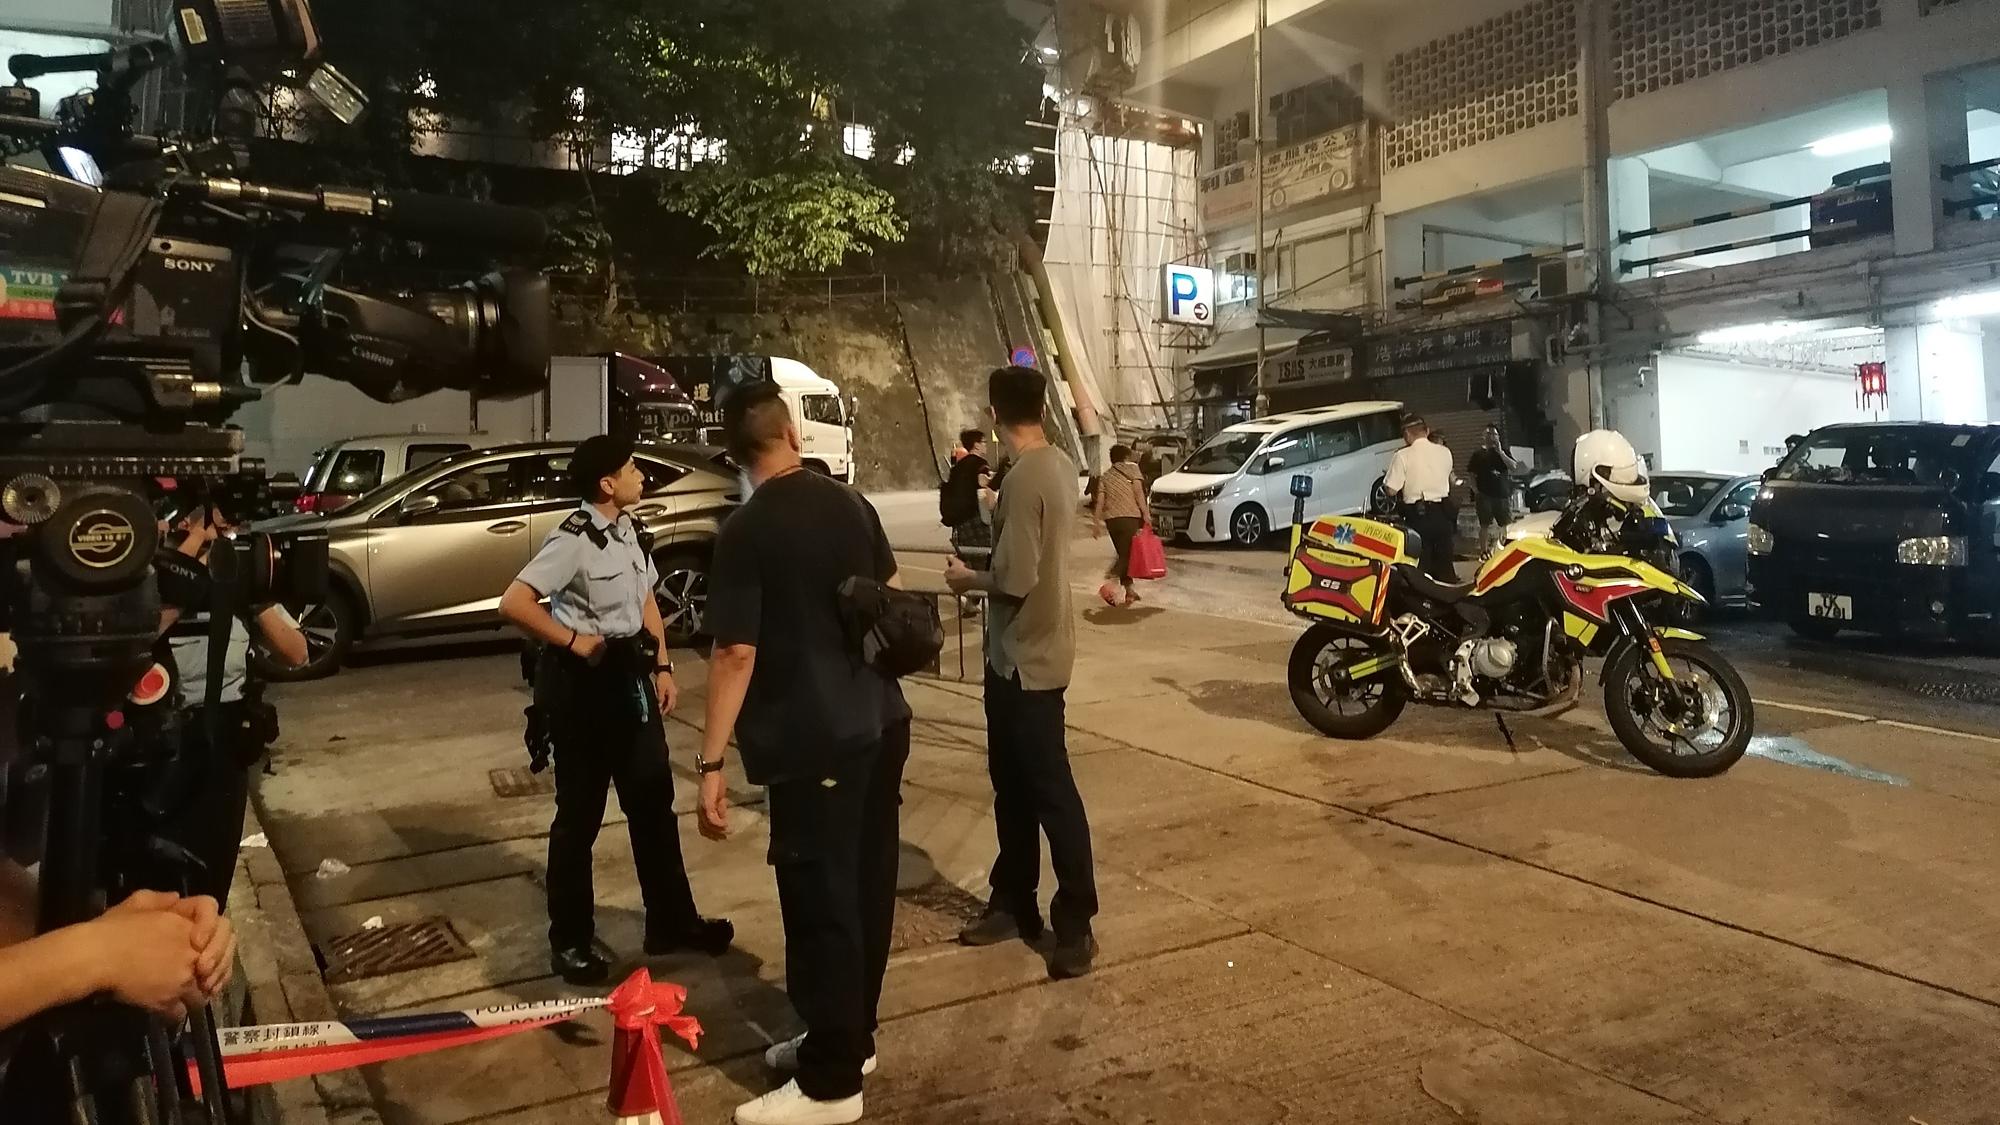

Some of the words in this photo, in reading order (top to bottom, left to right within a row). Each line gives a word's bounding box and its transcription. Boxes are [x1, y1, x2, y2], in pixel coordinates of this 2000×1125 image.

[164, 258, 216, 273] SONY
[11, 270, 54, 285] TVB
[1172, 272, 1198, 315] P
[1320, 578, 1341, 590] GS
